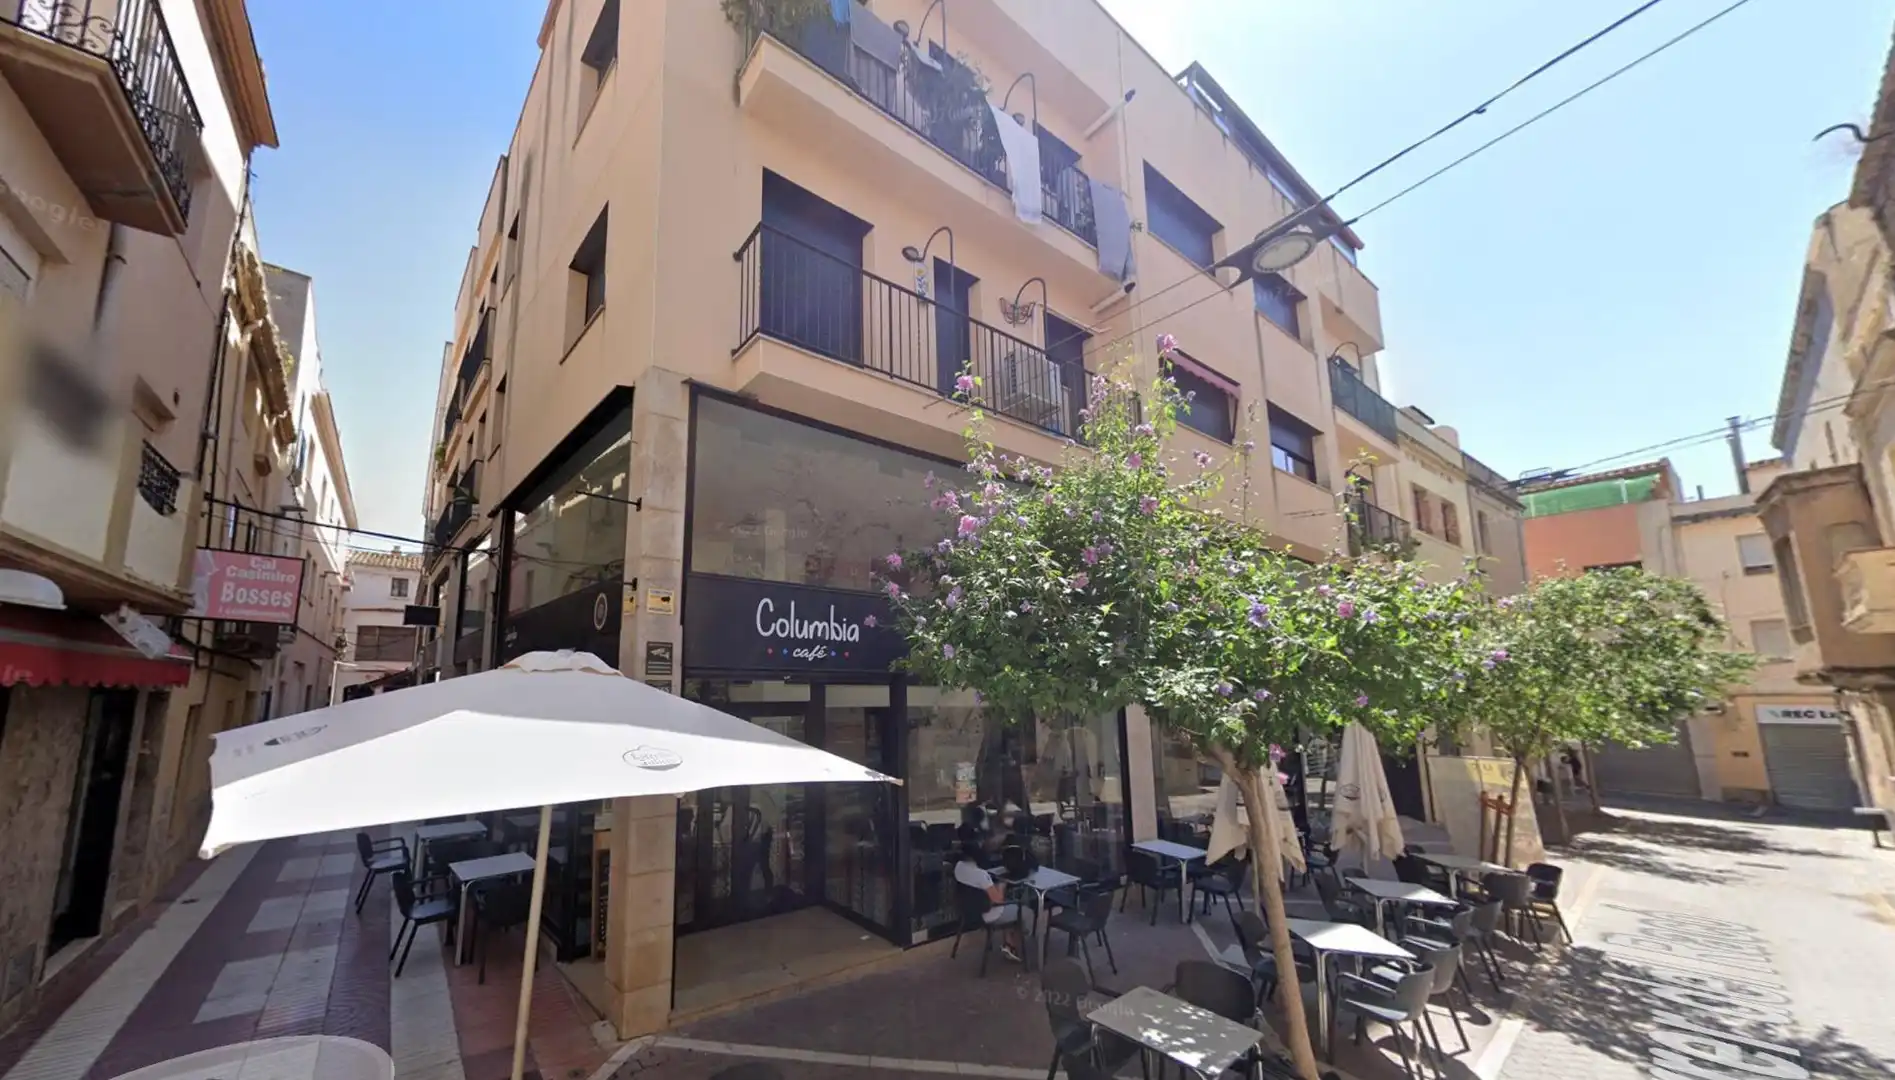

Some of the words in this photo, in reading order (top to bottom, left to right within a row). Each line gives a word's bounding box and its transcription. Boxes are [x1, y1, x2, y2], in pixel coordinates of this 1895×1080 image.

[249, 556, 276, 569] Cal
[220, 581, 294, 608] Bosses
[755, 597, 860, 642] Columbia
[792, 644, 827, 662] café
